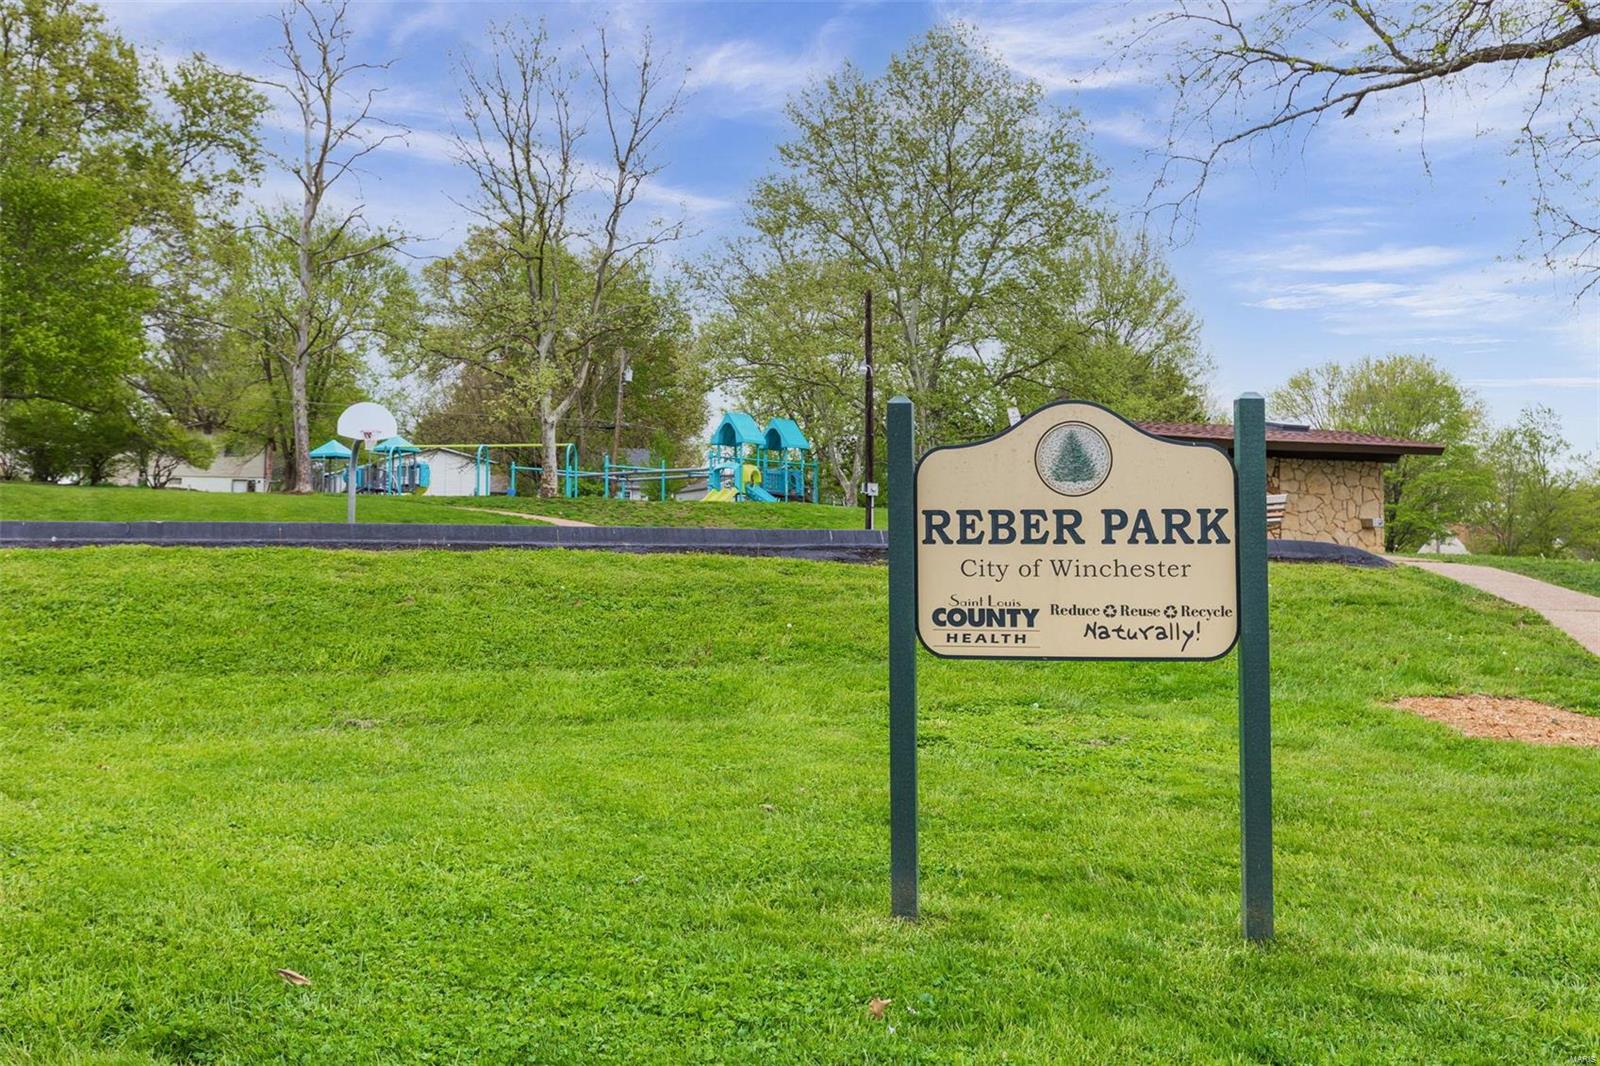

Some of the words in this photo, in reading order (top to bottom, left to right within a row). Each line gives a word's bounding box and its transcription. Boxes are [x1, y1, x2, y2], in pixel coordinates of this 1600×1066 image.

[921, 508, 1086, 545] REBER
[1101, 508, 1231, 545] PARK
[960, 559, 1009, 583] City
[1018, 559, 1043, 578] of
[1050, 559, 1192, 578] Winchester
[949, 594, 984, 608] Saint
[988, 595, 1022, 608] Louis
[932, 607, 1040, 628] COUNTY
[1050, 604, 1101, 617] Reduce
[1120, 605, 1161, 618] Reuse
[1181, 605, 1233, 621] Recycle
[946, 633, 1027, 644] HEALTH
[1083, 621, 1202, 652] Naturally!
